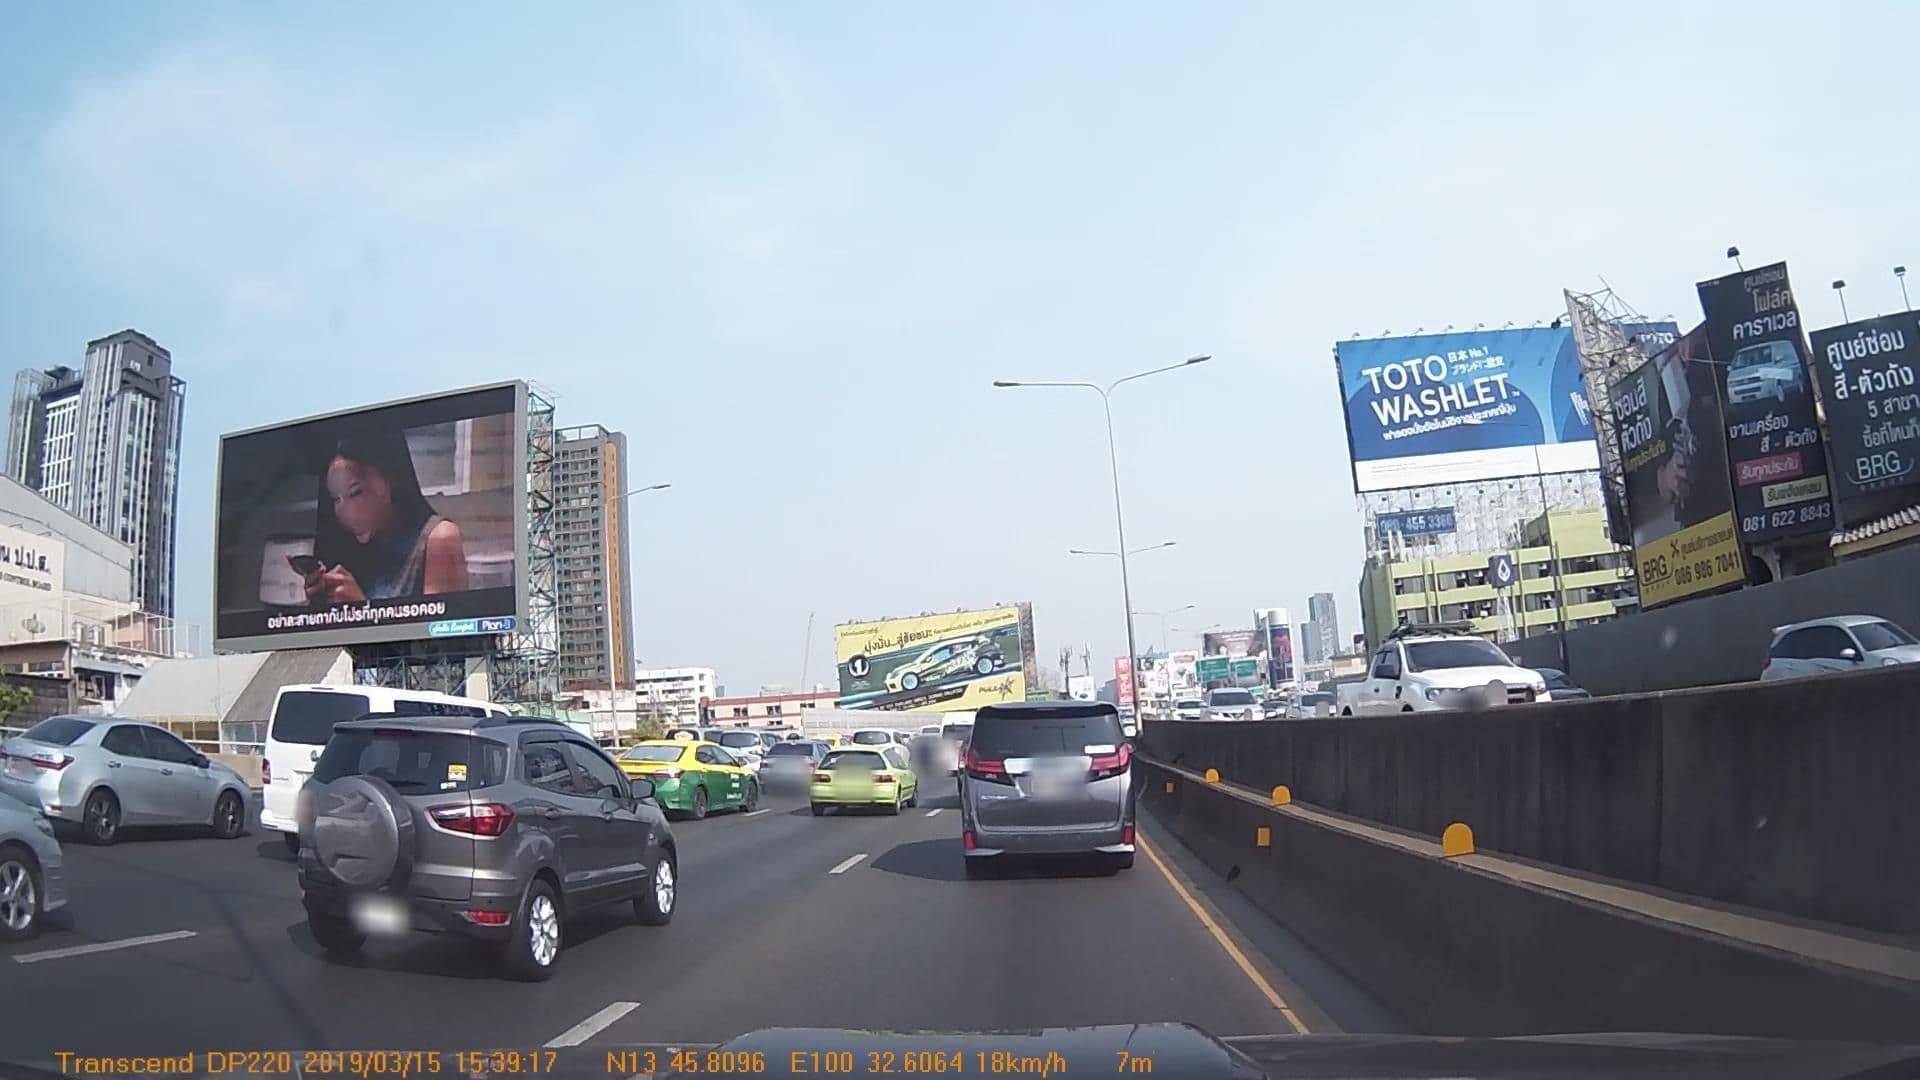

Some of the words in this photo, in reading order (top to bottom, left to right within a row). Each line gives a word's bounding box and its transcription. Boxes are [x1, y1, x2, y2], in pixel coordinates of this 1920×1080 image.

[1733, 311, 1797, 340] คาราเวล
[1826, 329, 1905, 371] ศูนย์ซ่อม
[1362, 355, 1448, 394] TOTO
[1868, 400, 1878, 418] 5
[1856, 451, 1901, 480] BRG
[1743, 515, 1766, 532] 081
[1772, 510, 1796, 528] 622
[1800, 503, 1831, 522] 8843
[1643, 555, 1668, 582] BRG
[1715, 550, 1740, 574] 7041
